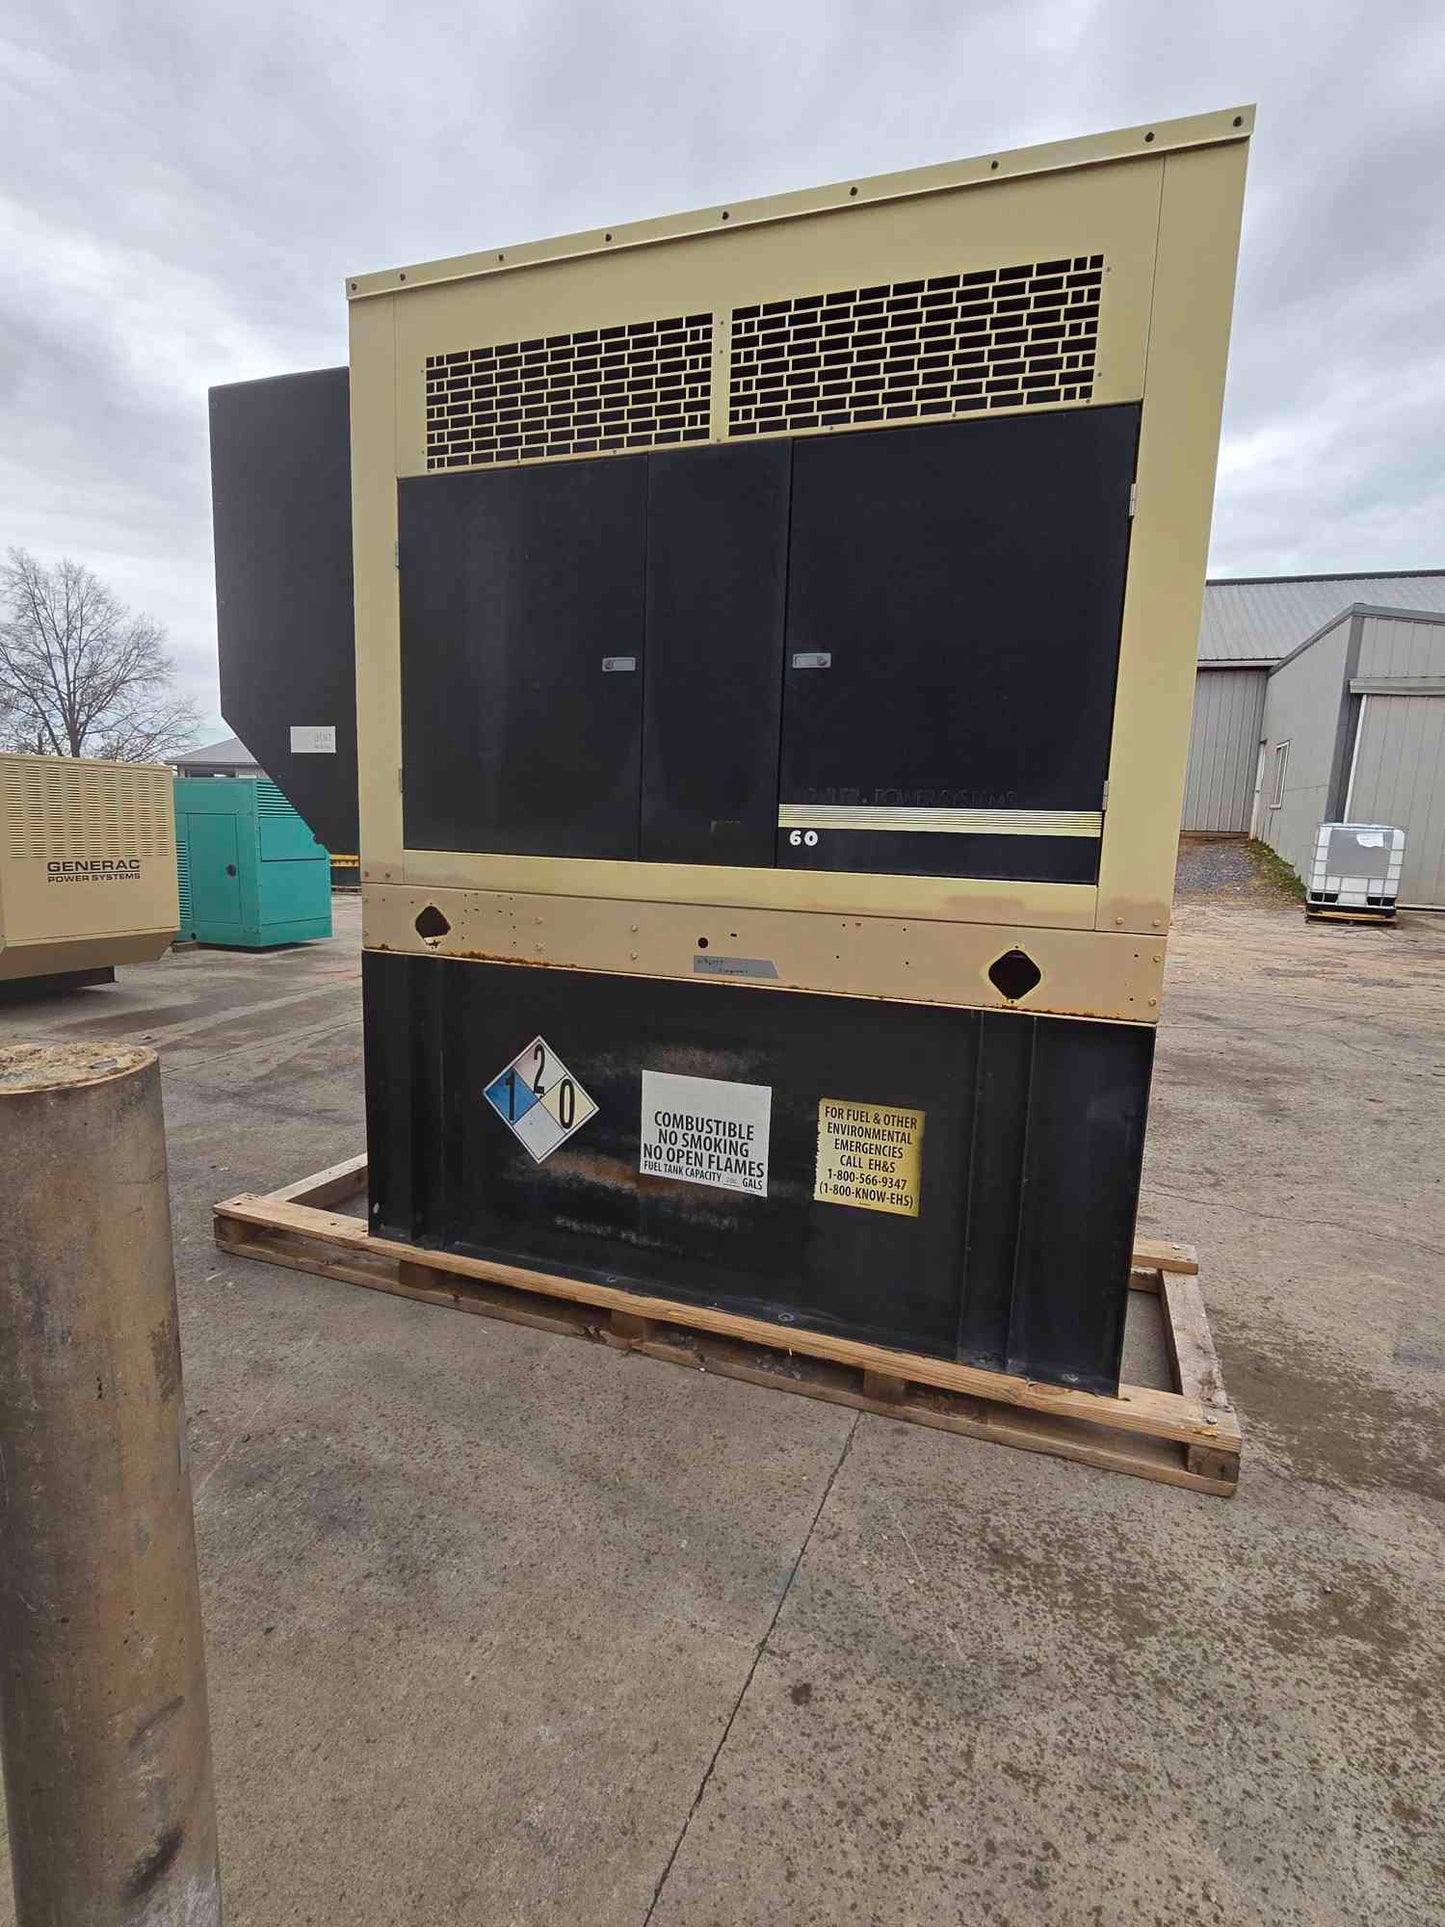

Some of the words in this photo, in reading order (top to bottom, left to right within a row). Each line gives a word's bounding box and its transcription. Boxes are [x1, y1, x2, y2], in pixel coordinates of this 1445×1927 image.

[789, 830, 819, 846] 60
[47, 859, 140, 873] GENERAC
[48, 875, 89, 883] POWER
[91, 873, 141, 881] SYSTEMS
[533, 1043, 545, 1094] 2
[505, 1070, 516, 1121] 1
[560, 1078, 575, 1129] 0
[654, 1111, 754, 1141] COMBUSTIBLE
[825, 1106, 844, 1120] FOR
[846, 1109, 870, 1124] FUEL
[873, 1112, 881, 1125] &
[883, 1113, 918, 1130] OTHER
[658, 1129, 678, 1146] NO
[681, 1133, 749, 1158] SMOKING
[827, 1122, 913, 1145] ENVIRONMENTAL
[643, 1143, 662, 1160] NO
[666, 1147, 703, 1167] OPEN
[708, 1154, 765, 1178] FLAMES
[834, 1138, 904, 1159] EMERGENCIES
[644, 1160, 662, 1172] FUEL
[664, 1163, 683, 1176] TANK
[685, 1167, 722, 1182] CAPACITY
[742, 1177, 763, 1190] GALS
[840, 1154, 864, 1169] CALL
[868, 1159, 896, 1173] EH&S
[827, 1168, 907, 1190] 1-800-566-9347
[819, 1181, 914, 1209] (1-800-KNOW-EHS)
